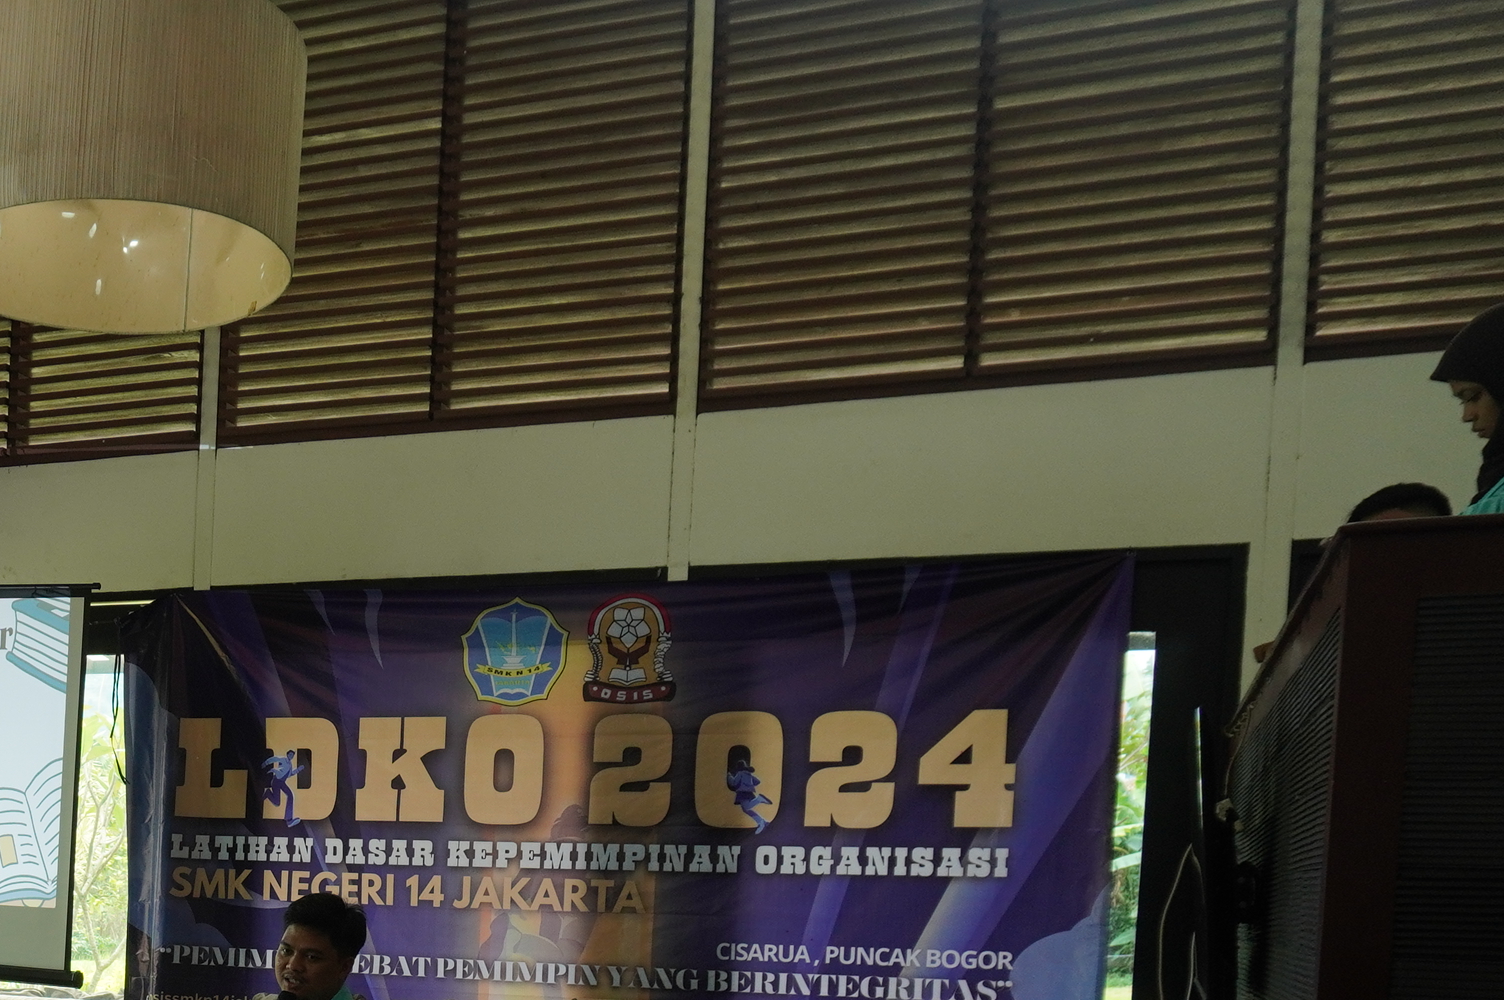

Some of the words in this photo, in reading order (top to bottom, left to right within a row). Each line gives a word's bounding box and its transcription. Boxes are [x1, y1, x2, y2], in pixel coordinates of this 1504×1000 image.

[486, 667, 512, 677] SMK
[527, 665, 541, 674] 14
[600, 688, 654, 700] OSIS
[174, 713, 545, 826] LDKO
[588, 708, 1017, 830] 2024
[170, 833, 314, 863] LATIHAN
[324, 837, 435, 866] DASAR
[446, 840, 741, 873] KEPEMIMPINAN
[754, 845, 1009, 878] ORGANISASI
[169, 866, 254, 900] SMK
[262, 869, 395, 905] NEGERI
[405, 874, 444, 908] 14
[452, 875, 647, 914] JAKARTA
[436, 957, 599, 985] PEMIMPIN
[599, 965, 700, 991] YANG
[824, 946, 922, 968] PUNCAK
[925, 949, 1014, 970] BOGOR
